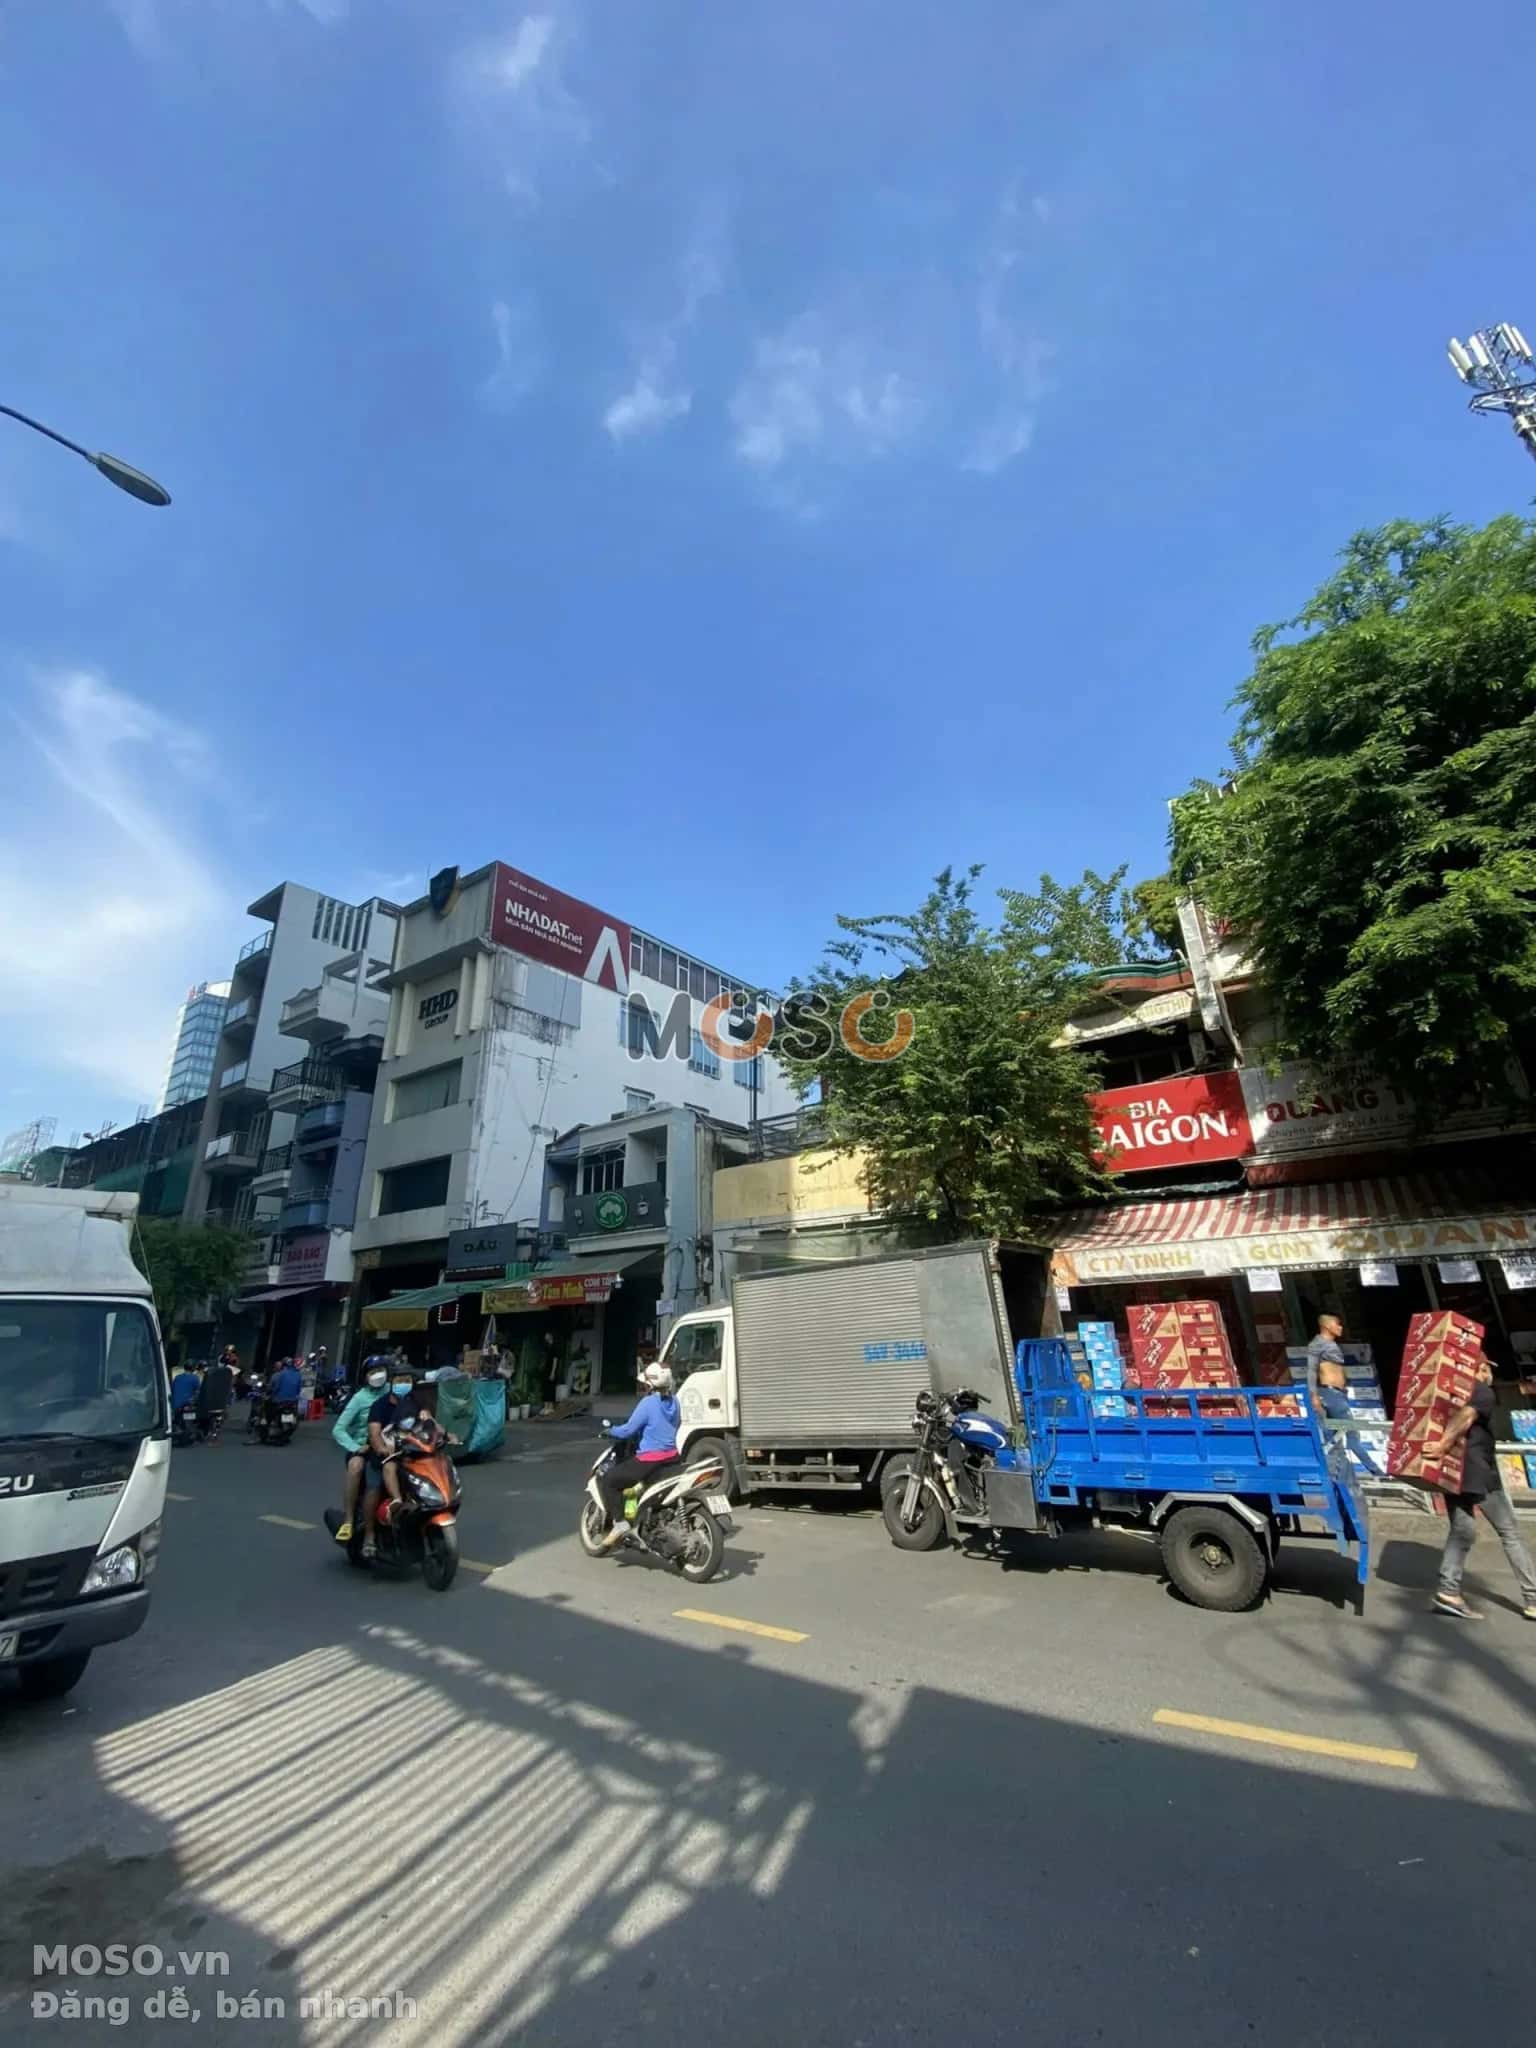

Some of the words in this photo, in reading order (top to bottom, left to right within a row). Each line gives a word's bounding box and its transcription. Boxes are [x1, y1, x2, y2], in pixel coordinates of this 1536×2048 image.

[1128, 1098, 1173, 1120] BIA
[1328, 1217, 1536, 1254] QUAN
[1088, 1256, 1126, 1273] CTY
[1128, 1252, 1193, 1270] TNHH
